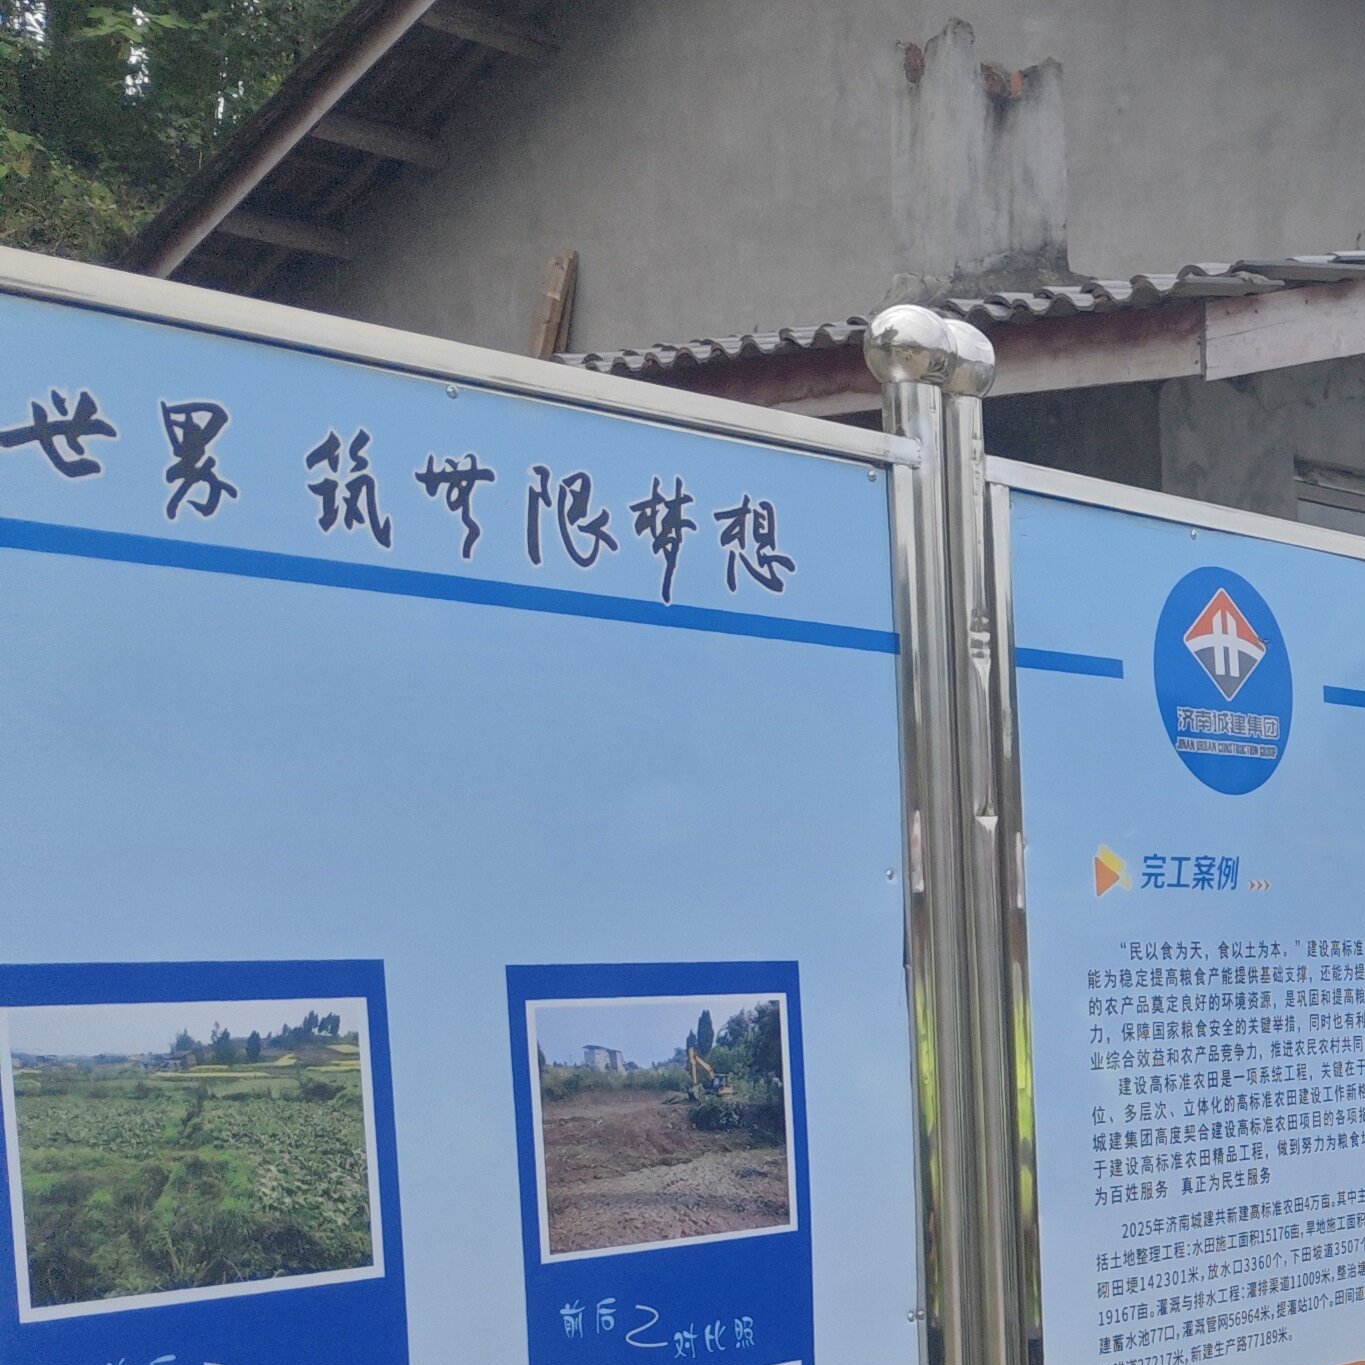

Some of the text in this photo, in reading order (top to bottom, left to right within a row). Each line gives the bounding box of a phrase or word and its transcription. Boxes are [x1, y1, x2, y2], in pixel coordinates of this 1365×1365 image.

[1177, 707, 1280, 740] 济南城建集团
[1140, 853, 1241, 891] 完工案例
[1094, 1166, 1271, 1207] 为百姓服务 真正为民生服务
